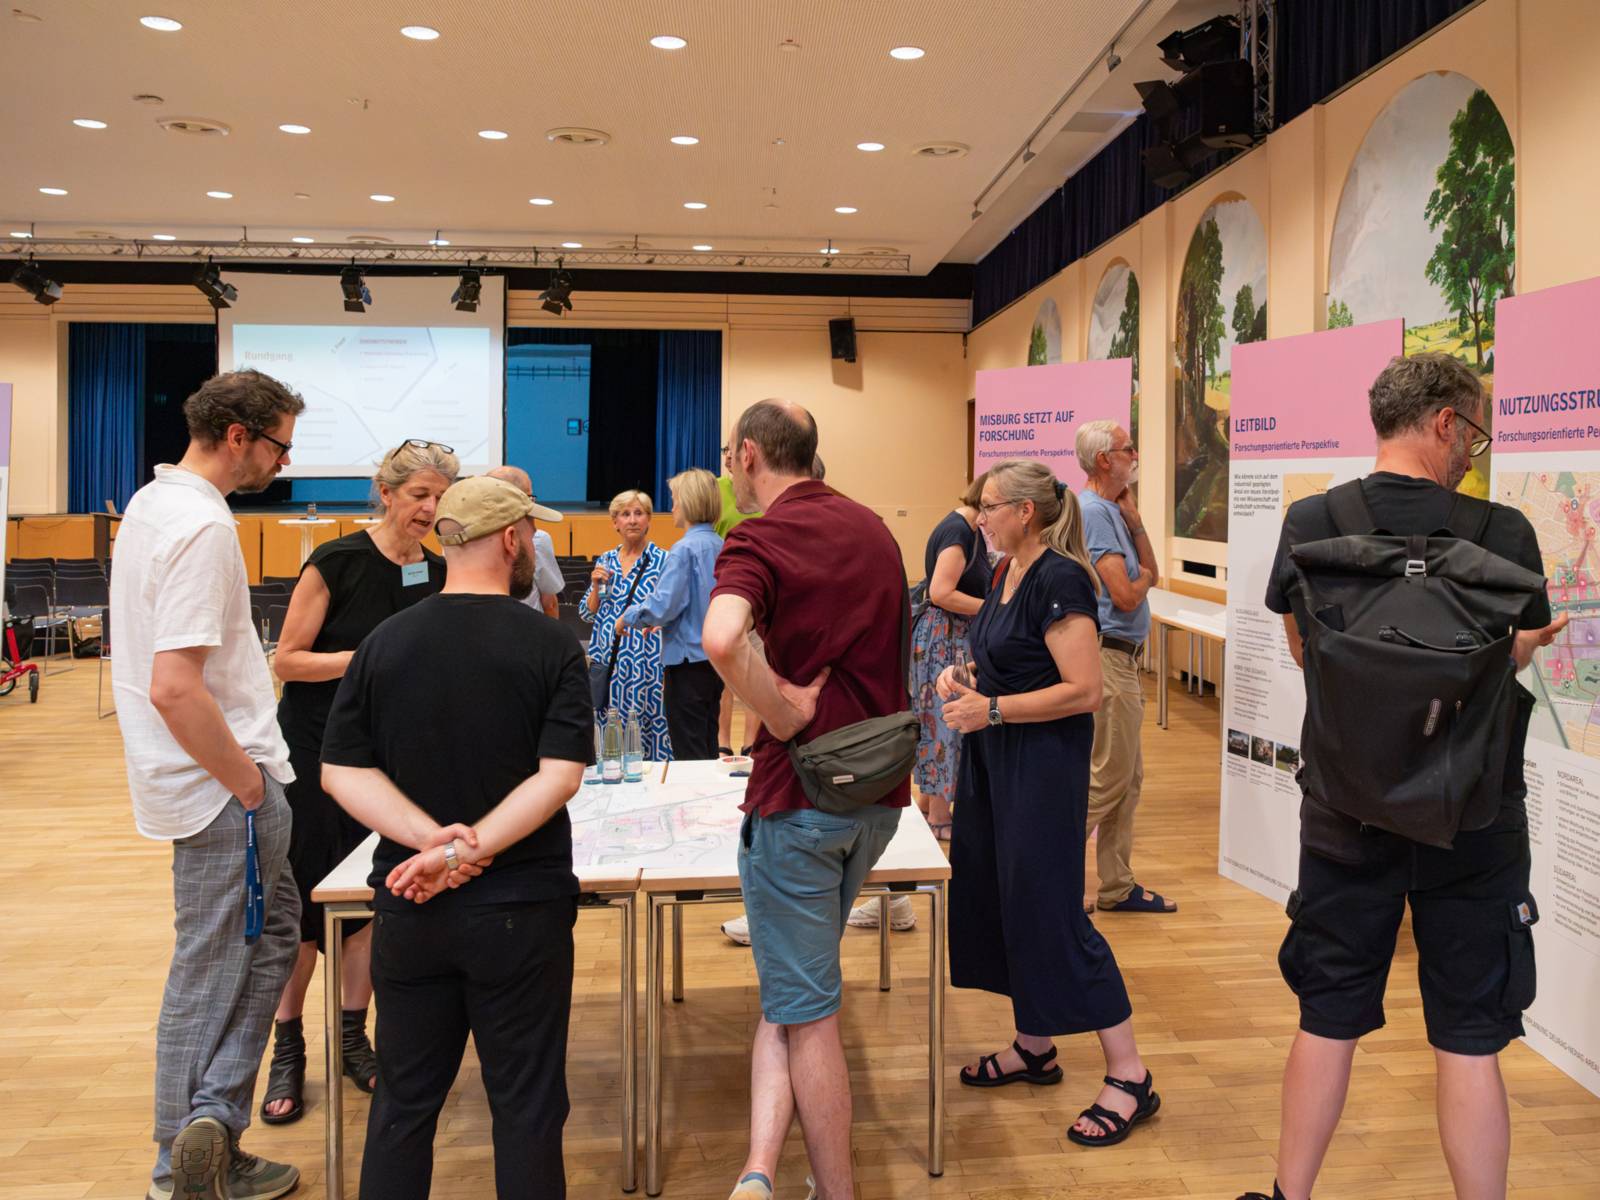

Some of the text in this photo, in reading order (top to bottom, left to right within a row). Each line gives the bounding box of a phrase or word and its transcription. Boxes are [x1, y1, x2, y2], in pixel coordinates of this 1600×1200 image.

[979, 410, 1075, 426] MISBURG SETZT AUF
[1235, 417, 1277, 433] LEITBILD
[979, 428, 1035, 442] FORSCHUNG
[1498, 427, 1585, 442] Forschungsorientierte
[1040, 448, 1075, 458] Perspektive
[1234, 439, 1340, 453] Forschungsorientierte Perspektive
